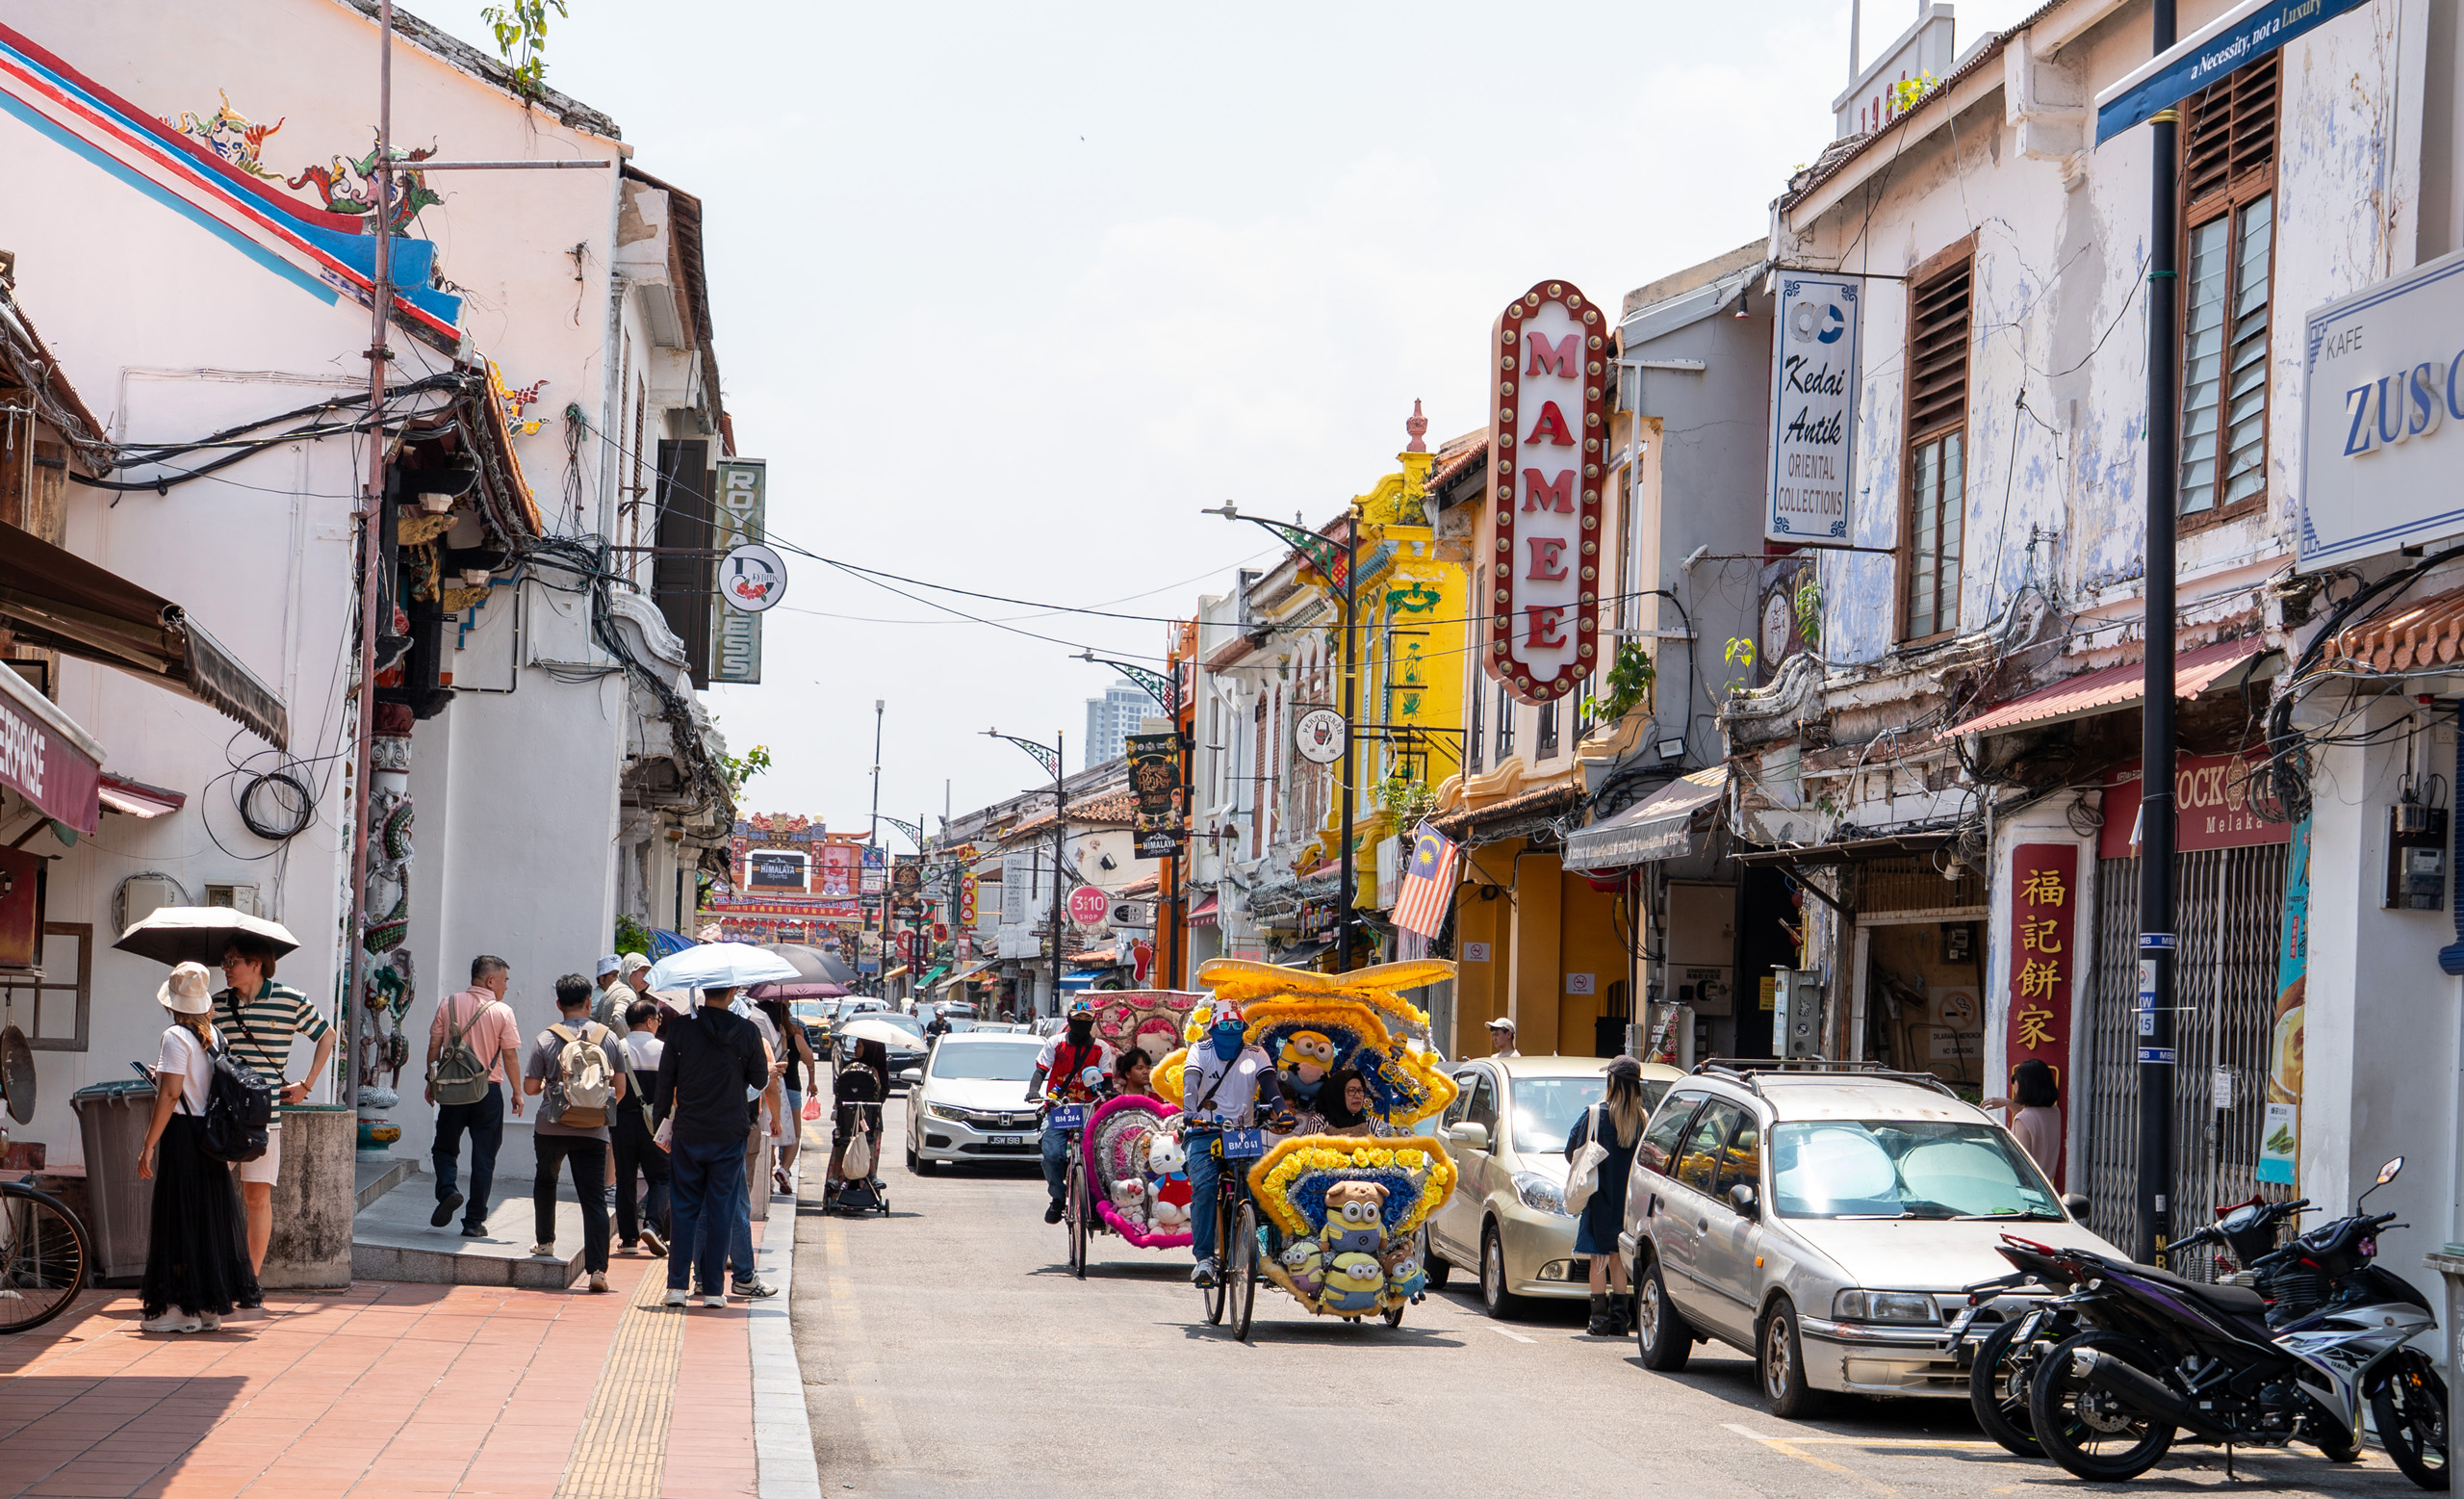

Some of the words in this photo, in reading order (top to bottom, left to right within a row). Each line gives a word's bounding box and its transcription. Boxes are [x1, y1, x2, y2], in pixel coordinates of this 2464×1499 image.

[2190, 65, 2197, 80] a
[2198, 35, 2251, 76] Necessity,
[2252, 20, 2271, 46] not
[2272, 17, 2280, 34] a
[2281, 0, 2322, 29] Luxury
[2326, 325, 2364, 361] KAFE
[1784, 354, 1845, 397] Kedai
[1784, 405, 1842, 446] Antik
[1787, 452, 1835, 480] ORIENTAL
[1520, 331, 1581, 650] MAMEE
[1778, 486, 1843, 516] COLLECTIONS
[725, 470, 756, 547] ROYA
[2174, 764, 2226, 811] OCK
[2205, 813, 2264, 835] Melaka
[1142, 839, 1176, 851] HIMALAYA
[760, 863, 795, 875] HIMALAYA
[1074, 895, 1084, 911] 3
[1089, 895, 1104, 911] 10
[2015, 869, 2066, 1050] 福記餅家
[1228, 1142, 1242, 1150] BM
[1244, 1140, 1258, 1150] 041
[2330, 1360, 2352, 1373] YAMAHA
